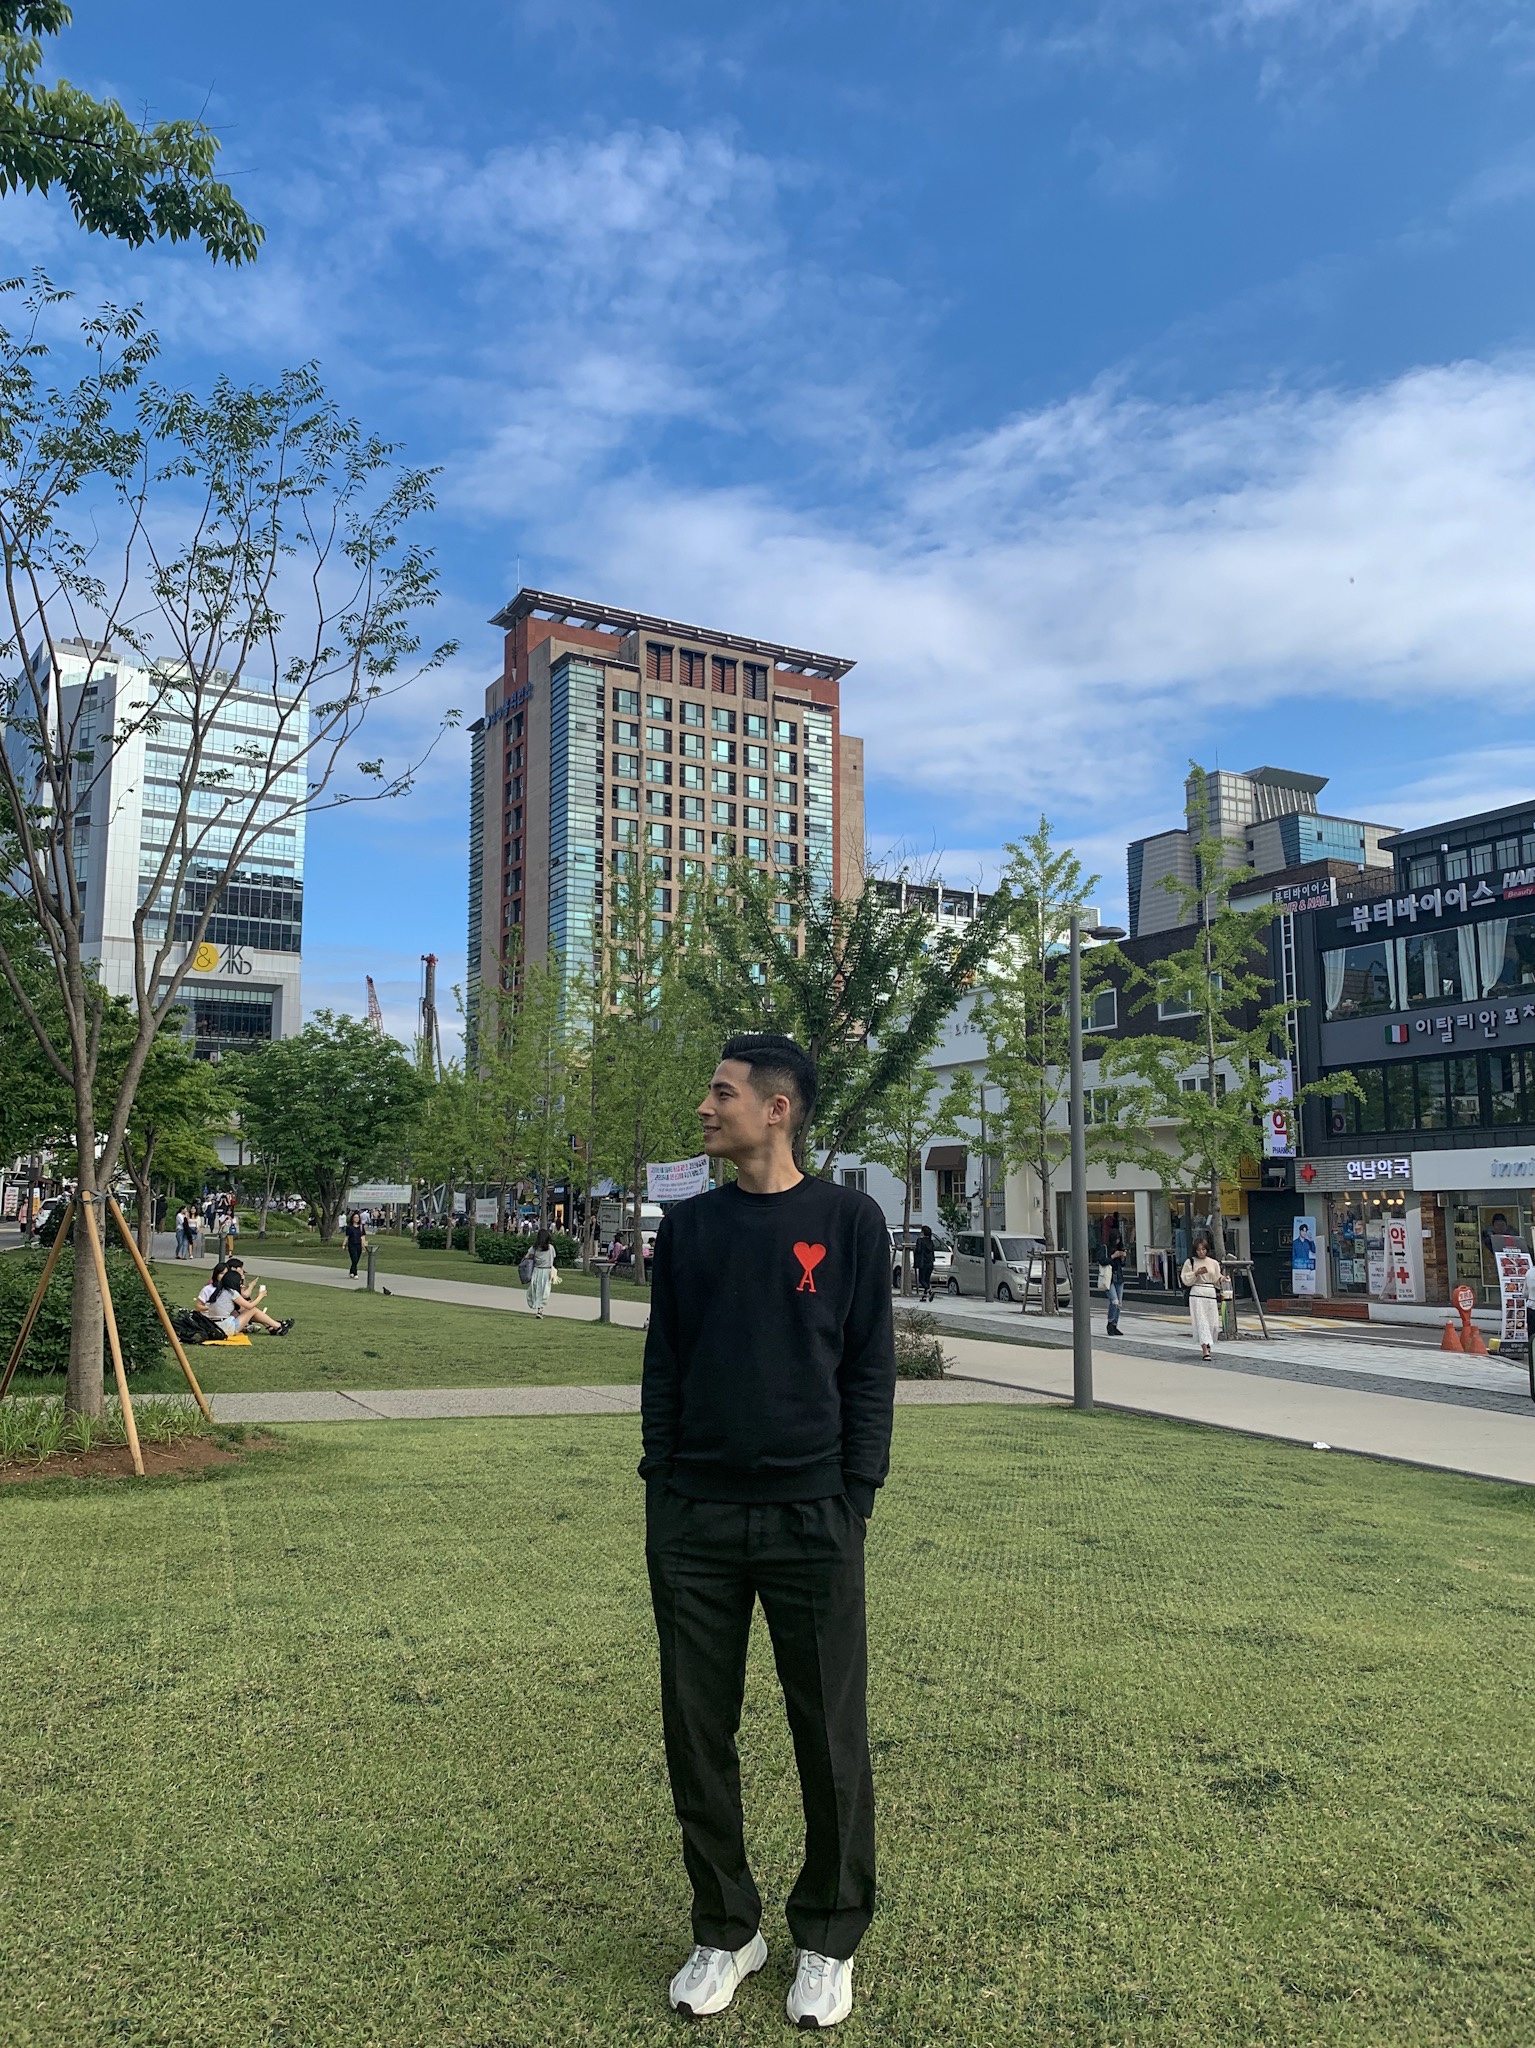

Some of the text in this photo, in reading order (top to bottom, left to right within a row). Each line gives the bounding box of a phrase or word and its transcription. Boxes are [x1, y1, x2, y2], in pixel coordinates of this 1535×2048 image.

[1274, 881, 1330, 903] 뷰티바이어스
[1307, 894, 1330, 909] NAIL
[1508, 888, 1533, 898] Beauty
[1351, 881, 1496, 933] 뷰티바이어스
[219, 945, 243, 960] AK
[219, 960, 252, 975] AND
[1415, 1010, 1497, 1043] 이탈리안
[1346, 1158, 1410, 1181] 연남약국
[1391, 1228, 1405, 1249] 약
